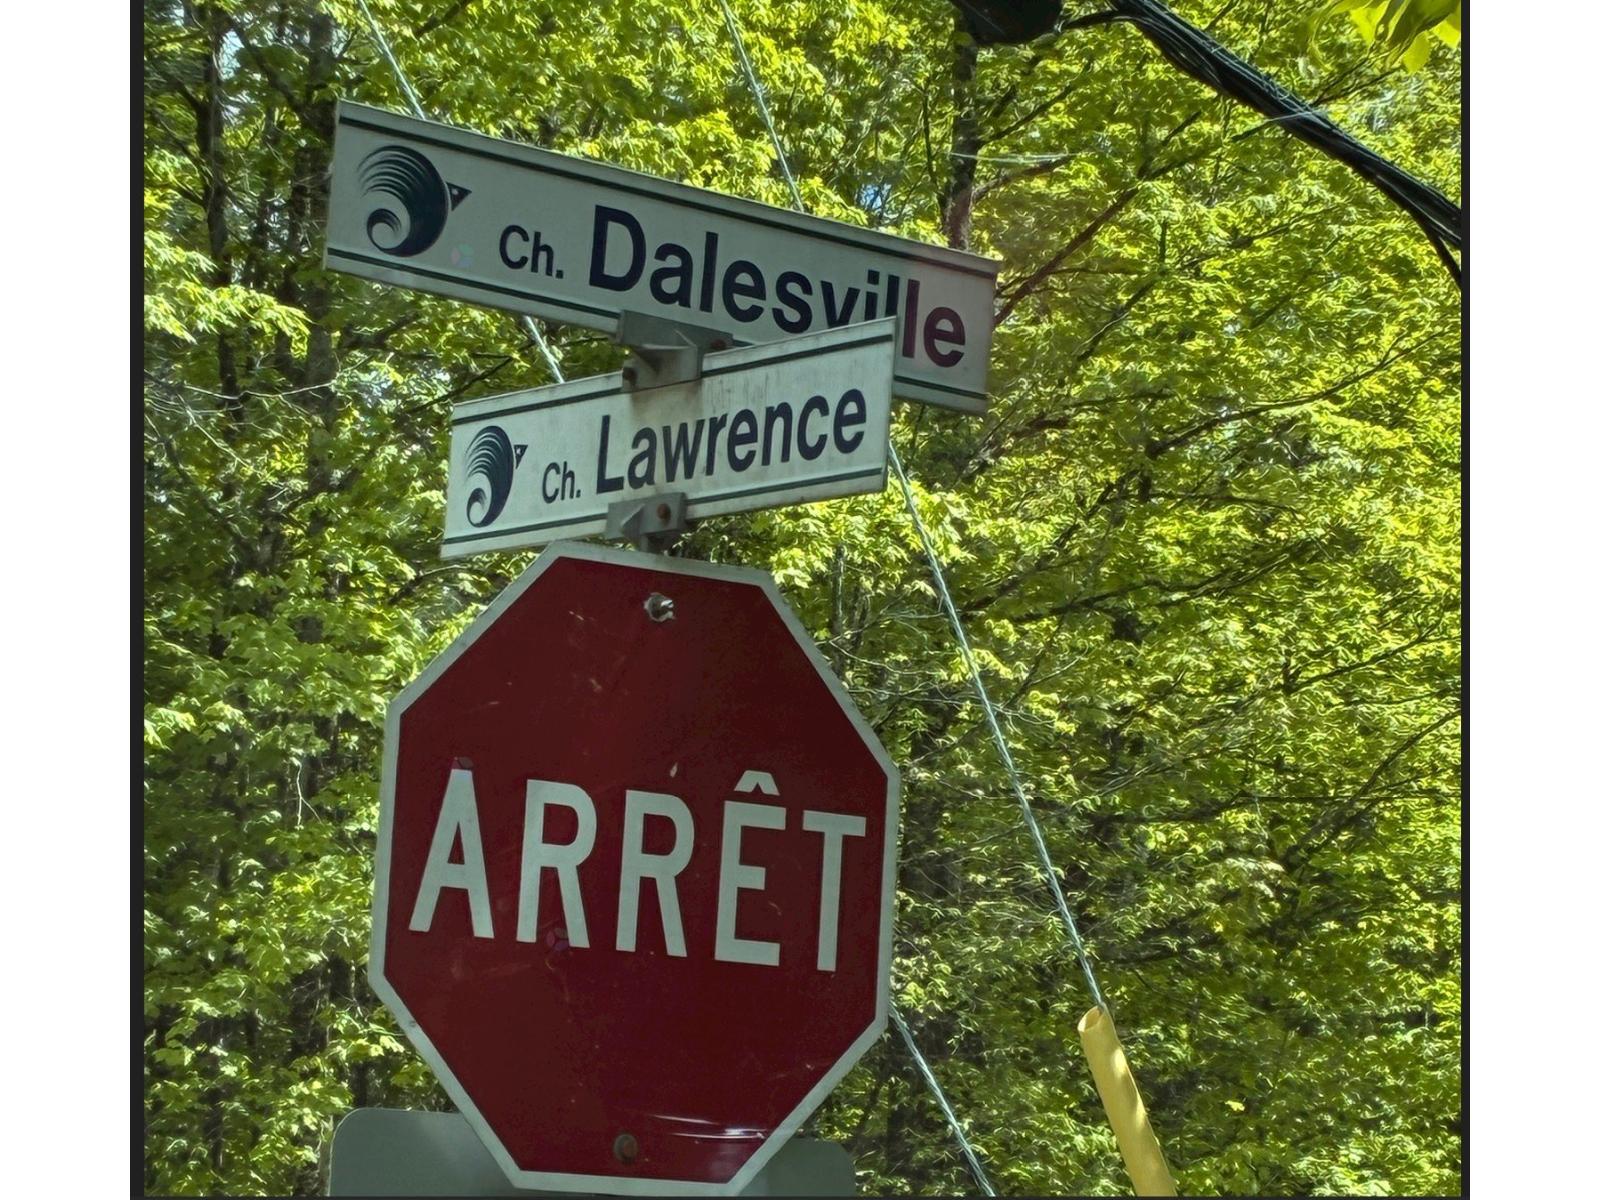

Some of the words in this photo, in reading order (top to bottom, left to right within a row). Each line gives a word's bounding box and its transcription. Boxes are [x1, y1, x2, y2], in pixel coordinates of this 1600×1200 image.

[499, 225, 564, 279] Ch.
[542, 461, 581, 503] Ch.
[596, 389, 867, 495] Lawrence
[408, 768, 867, 972] ARRÊT
